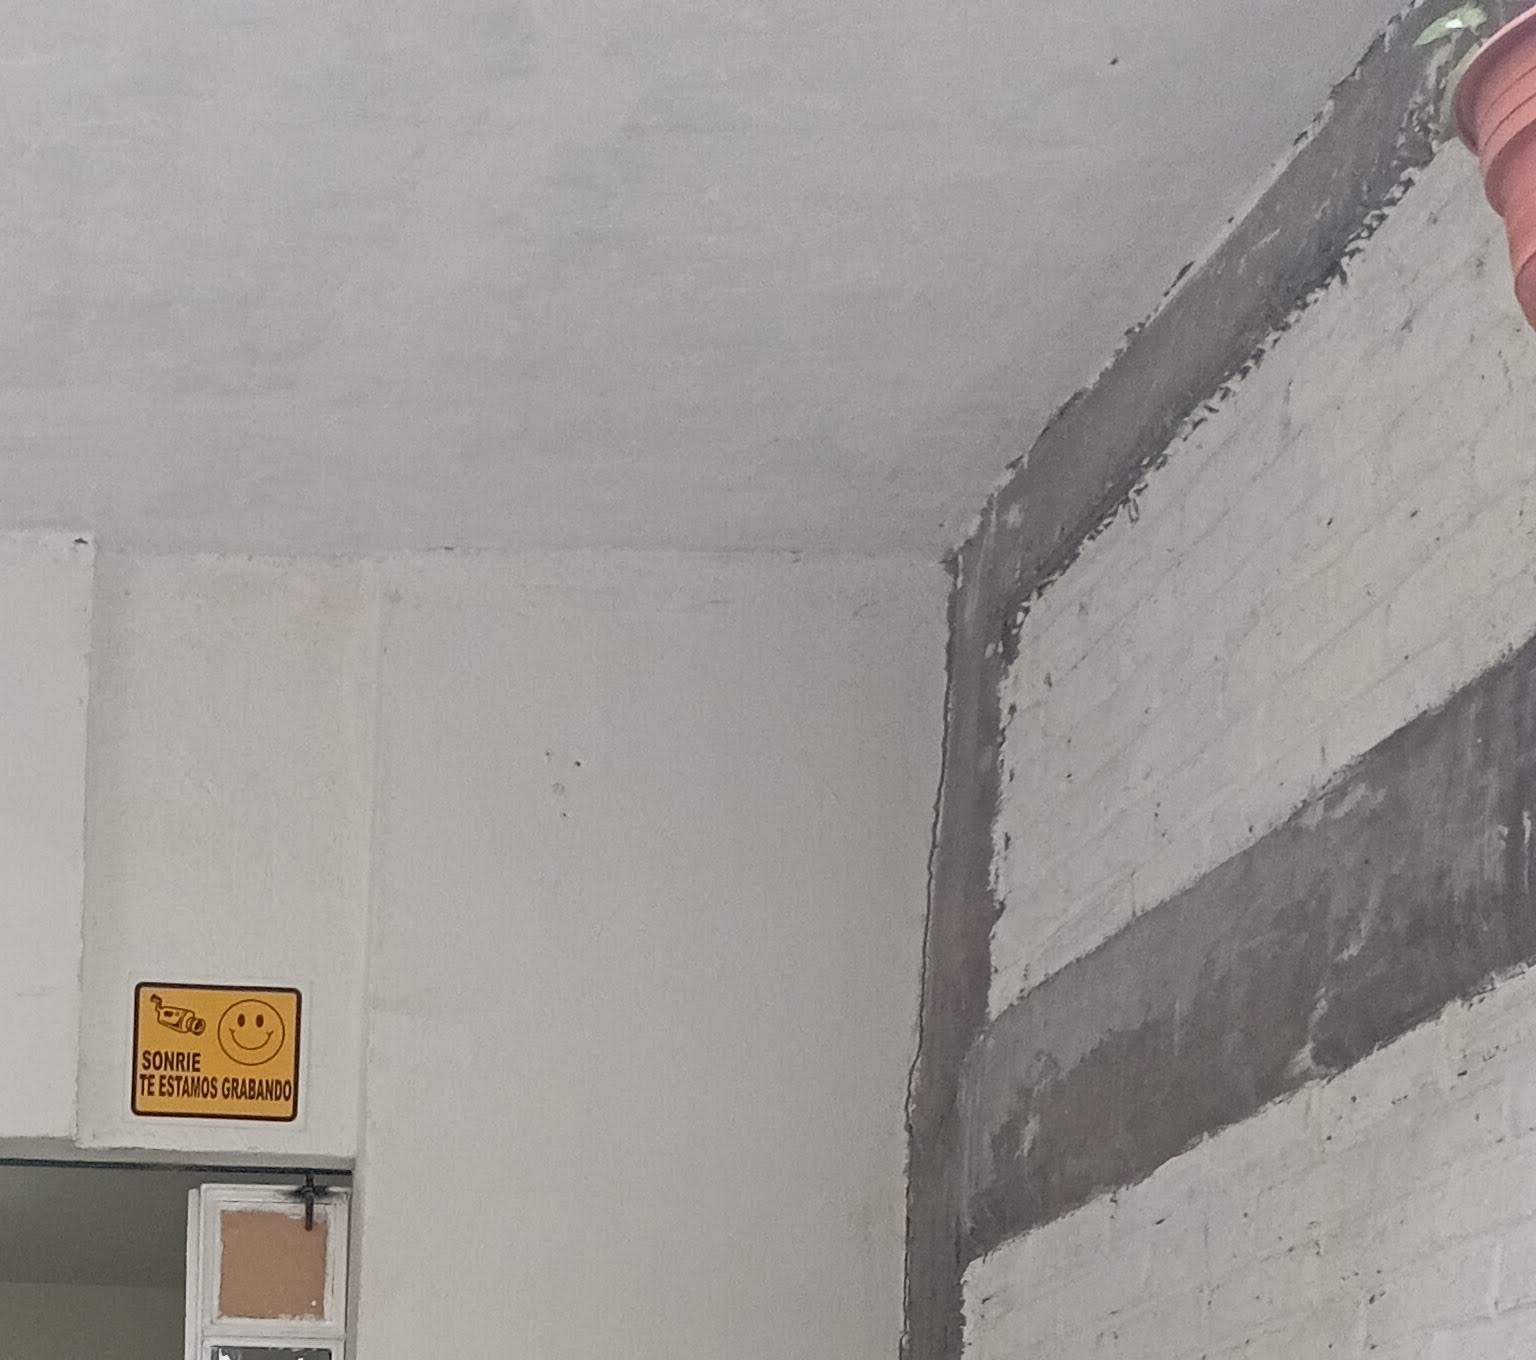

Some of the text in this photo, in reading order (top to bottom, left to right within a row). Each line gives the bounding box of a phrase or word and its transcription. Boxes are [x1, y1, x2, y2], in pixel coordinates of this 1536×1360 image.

[142, 1050, 201, 1073] SONRIE
[139, 1074, 292, 1102] TE ESTAMOS GRABANDO
